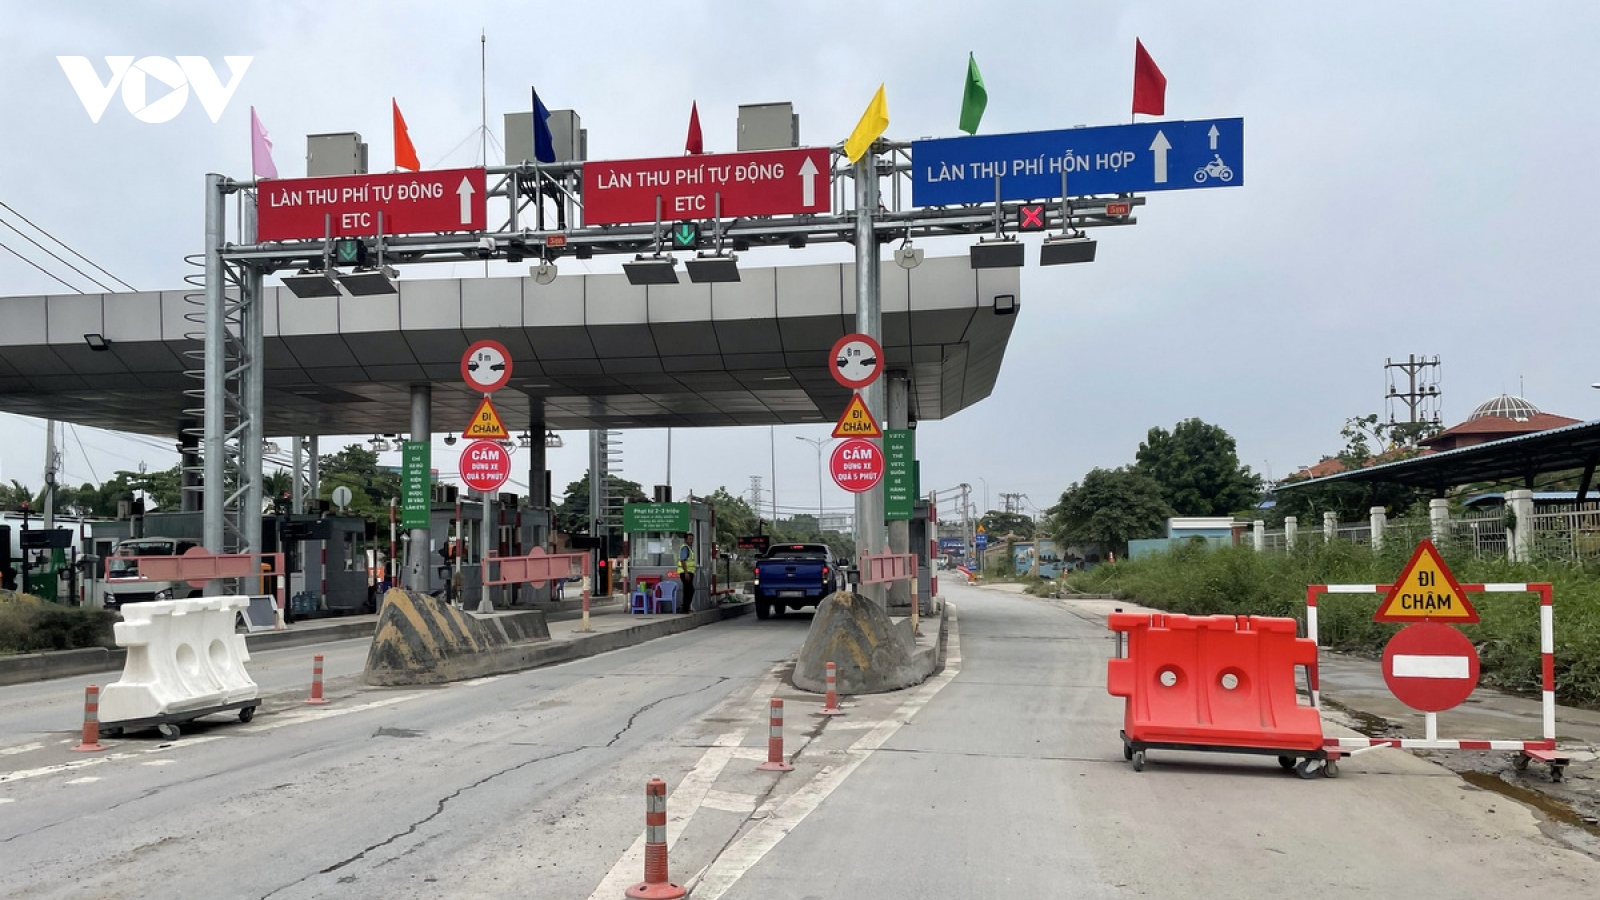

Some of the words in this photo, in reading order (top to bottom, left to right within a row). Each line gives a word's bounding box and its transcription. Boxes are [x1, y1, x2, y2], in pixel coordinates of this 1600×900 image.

[927, 161, 965, 183] LÀN
[969, 160, 1007, 179] THU
[1012, 153, 1045, 176] PHÍ
[1049, 149, 1090, 174] HỖN
[1095, 150, 1136, 173] HỢP
[597, 169, 632, 189] LÀN
[636, 169, 670, 187] THU
[675, 164, 705, 185] PHÍ
[707, 165, 731, 186] TỰ
[735, 161, 785, 184] ĐỘNG
[271, 187, 302, 207] LÀN
[306, 188, 337, 205] THU
[342, 183, 370, 203] PHÍ
[372, 183, 394, 204] TỰ
[397, 181, 443, 203] ĐỘNG
[675, 194, 706, 212] ETC
[342, 212, 371, 229] ETC
[482, 412, 492, 421] ĐI
[852, 409, 863, 419] ĐI
[472, 422, 500, 435] CHẬM
[843, 420, 872, 434] CHẬM
[471, 446, 500, 460] CẤM
[843, 446, 873, 459] CẤM
[863, 462, 872, 470] XE
[487, 472, 503, 480] PHÚT
[860, 471, 877, 480] PHÚT
[1417, 570, 1435, 587] ĐI
[1401, 590, 1452, 613] CHẬM
